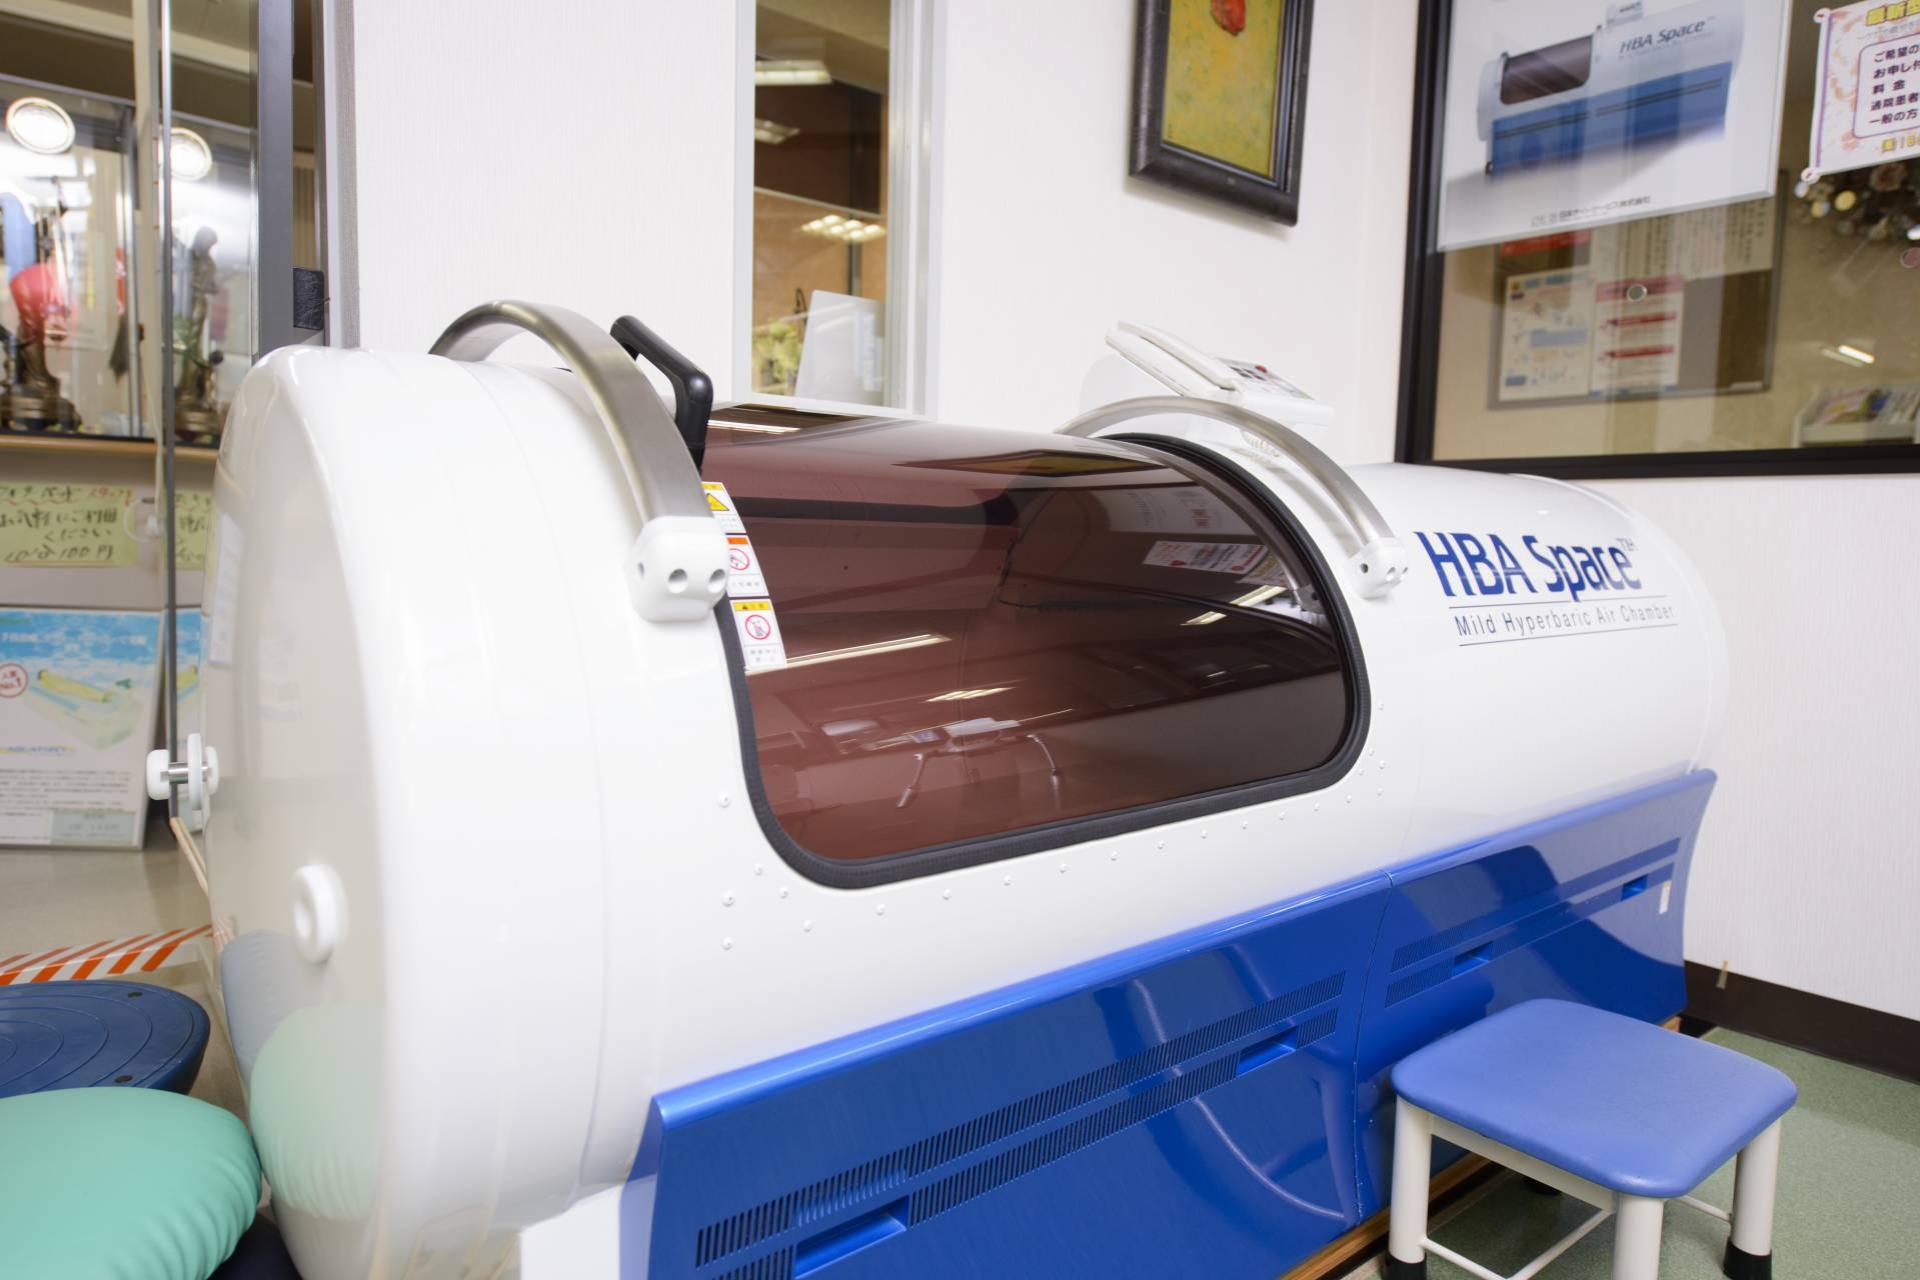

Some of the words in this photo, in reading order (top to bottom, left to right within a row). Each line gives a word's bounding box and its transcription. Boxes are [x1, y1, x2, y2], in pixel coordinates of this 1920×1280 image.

[1620, 34, 1652, 53] HBA
[1657, 21, 1705, 43] Space
[1413, 531, 1538, 597] HBA
[1522, 535, 1642, 602] Space
[1454, 614, 1497, 637] Mild
[1504, 609, 1592, 637] Hyperbaric
[1597, 607, 1617, 625] Air
[1620, 604, 1675, 624] Chamber
